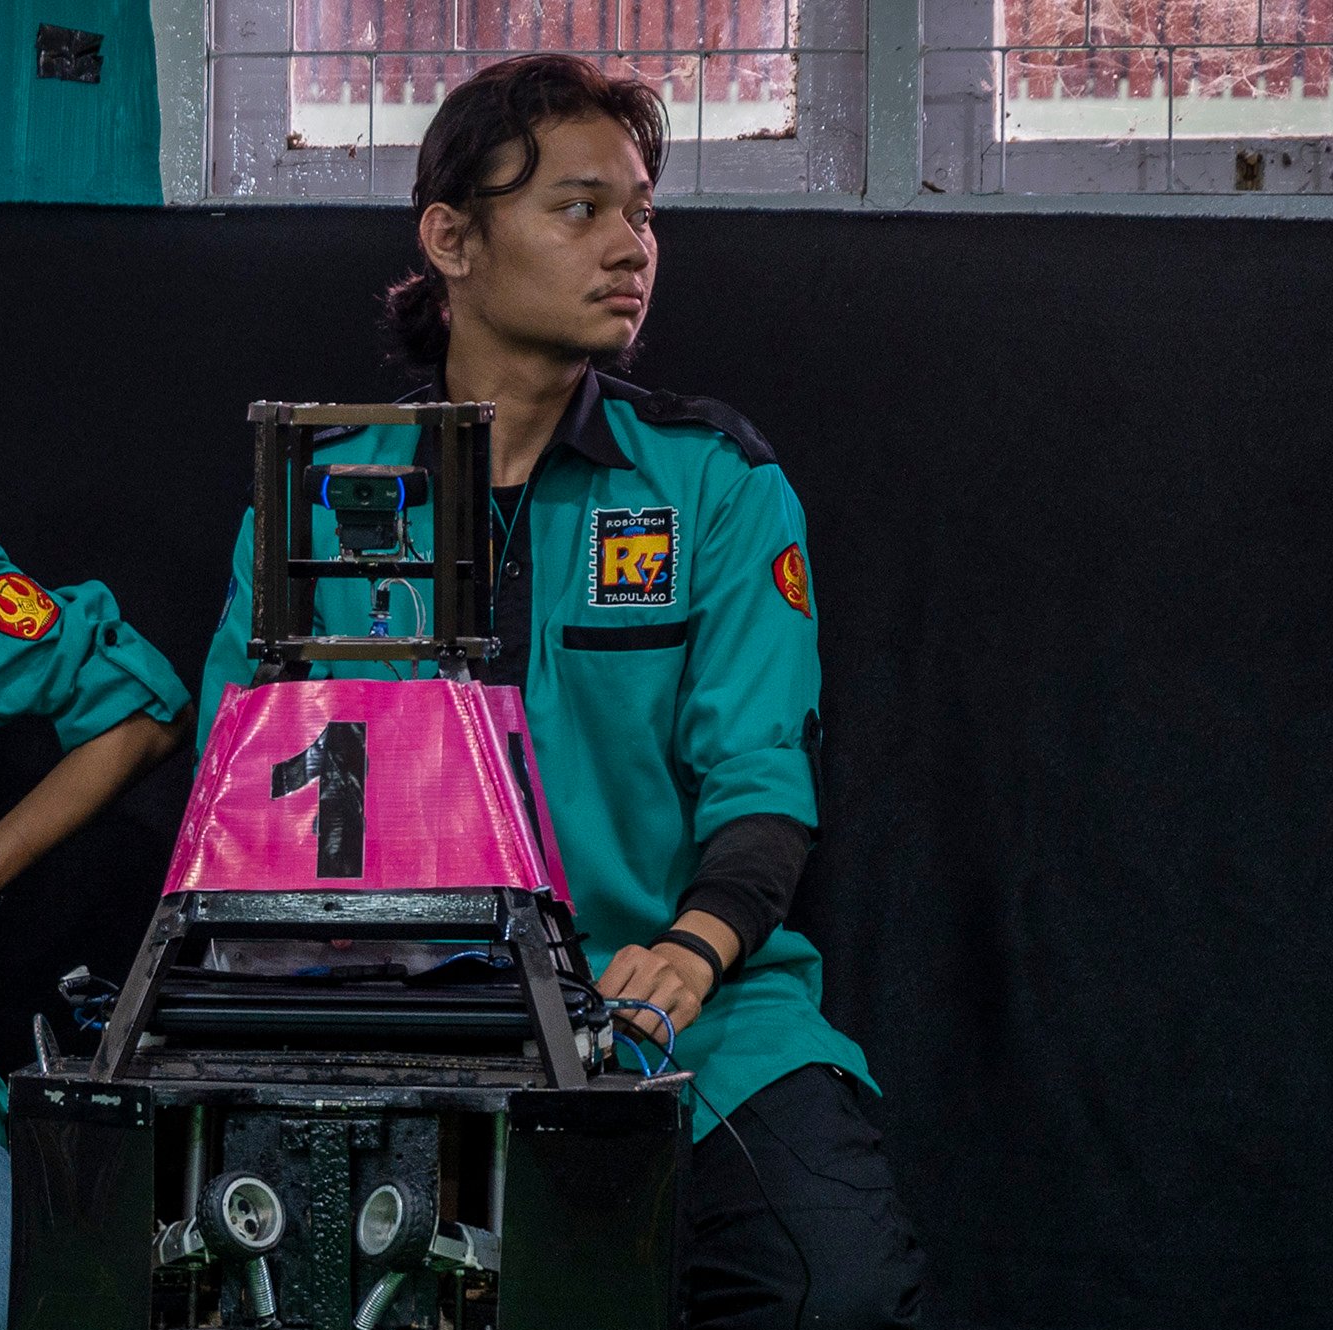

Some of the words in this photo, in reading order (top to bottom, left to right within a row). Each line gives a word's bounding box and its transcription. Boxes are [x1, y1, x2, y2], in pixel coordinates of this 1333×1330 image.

[606, 518, 665, 528] ROBOTECH
[605, 593, 666, 602] TADULAKO
[270, 721, 367, 879] 1
